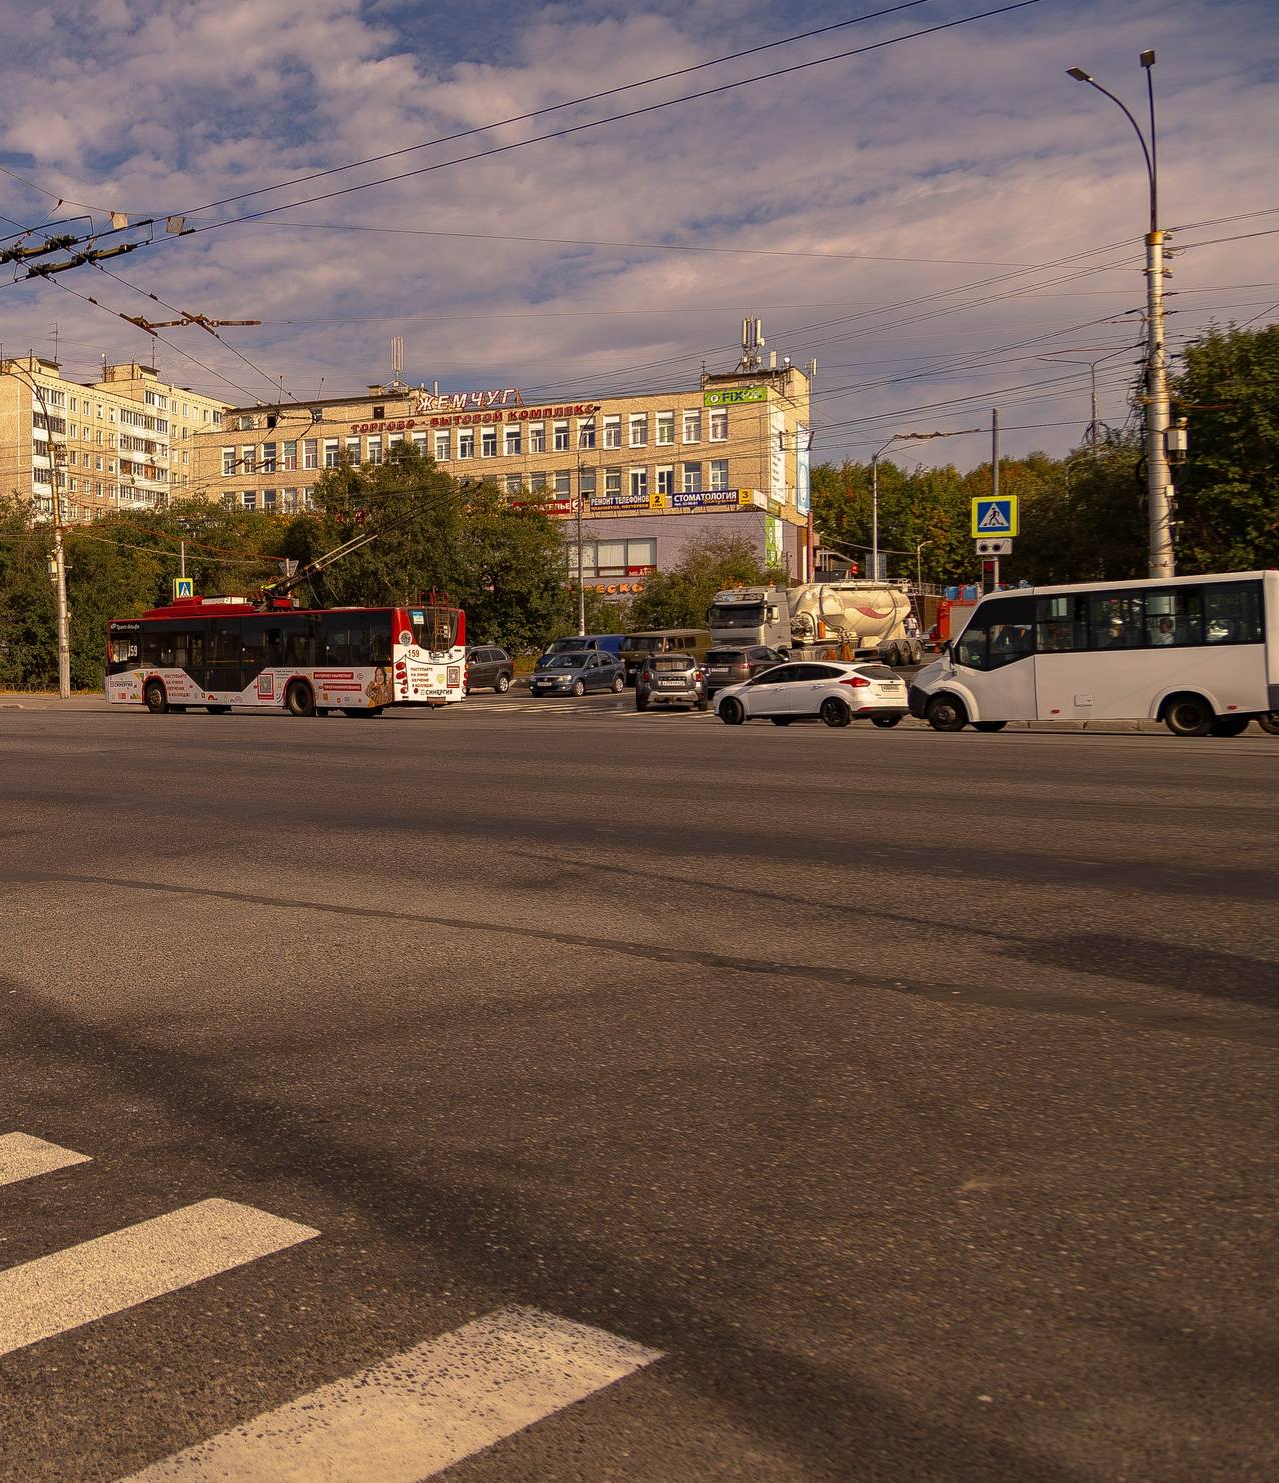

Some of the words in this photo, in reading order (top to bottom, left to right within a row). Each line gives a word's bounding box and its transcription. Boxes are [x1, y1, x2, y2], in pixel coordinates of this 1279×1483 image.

[416, 388, 515, 412] ЖЕМЧУГ
[351, 418, 416, 434] ТОРГОВО
[429, 408, 503, 428] БЫТОВОЙ
[507, 403, 594, 421] КОМПЛЕКС
[654, 495, 661, 503] 2
[674, 491, 737, 503] СТОМАТОЛОГИЯ
[742, 490, 749, 499] 3
[591, 497, 614, 506] РЕМОНТ
[615, 495, 650, 505] ТЕЛЕФОНОВ
[408, 649, 420, 658] 159
